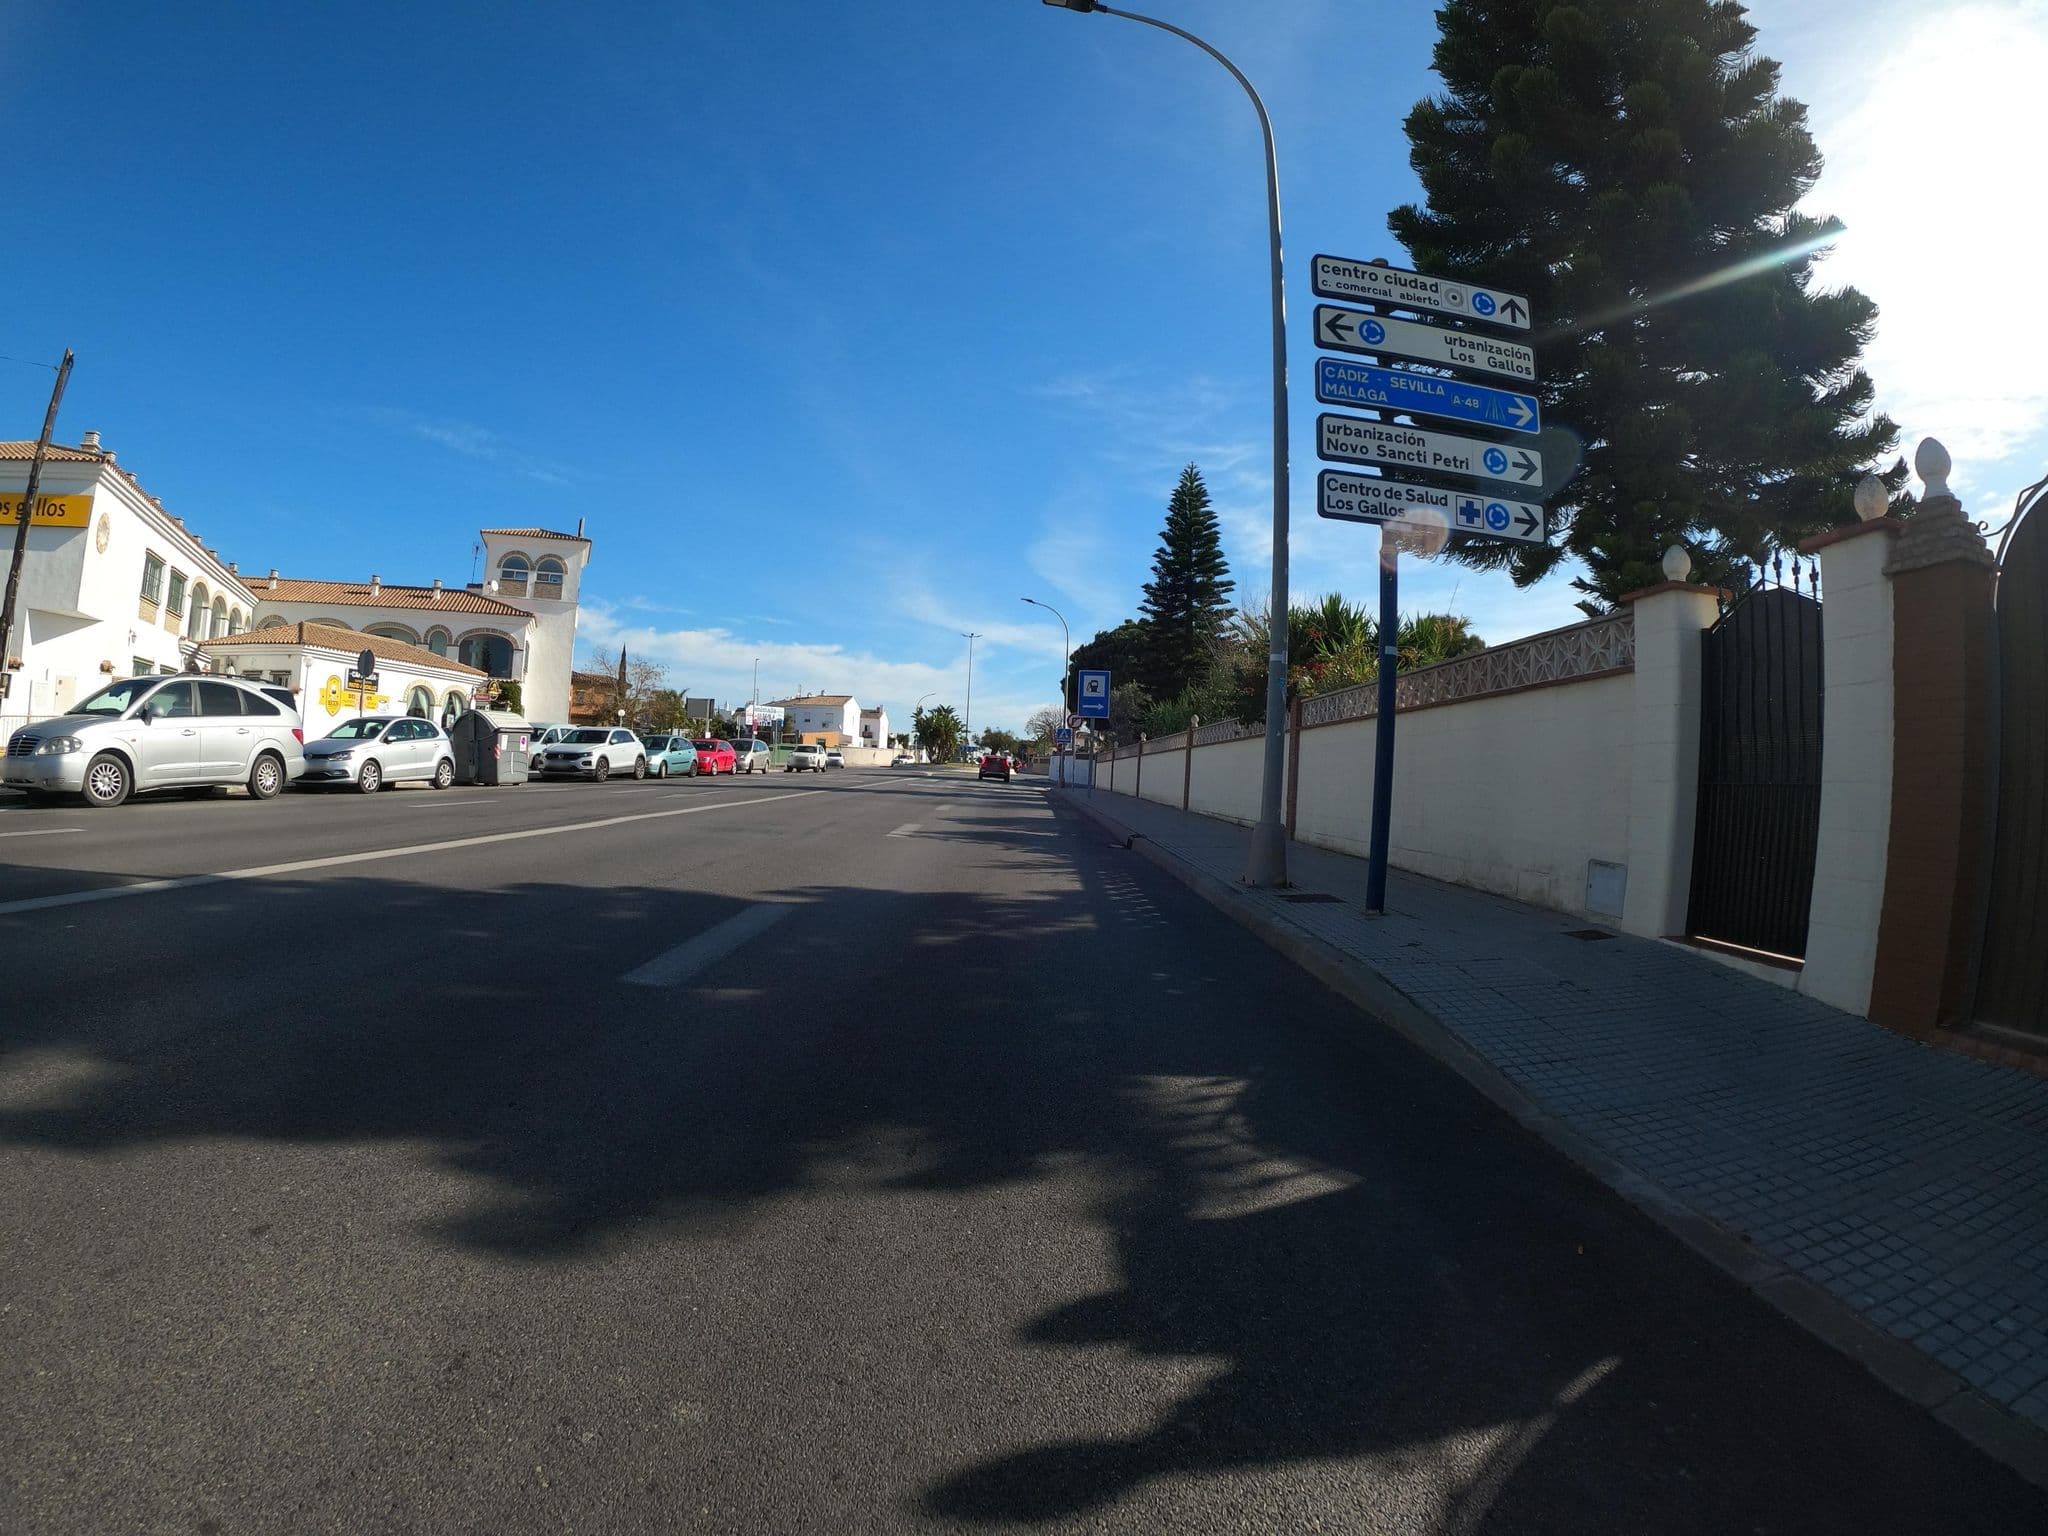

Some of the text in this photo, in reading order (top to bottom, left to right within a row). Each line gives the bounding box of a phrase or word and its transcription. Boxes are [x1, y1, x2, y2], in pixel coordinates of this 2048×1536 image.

[1321, 263, 1439, 294] centro ciudad
[1321, 278, 1440, 306] c. comercial abierto
[1444, 335, 1531, 362] urbanización
[1450, 348, 1532, 376] Los Gallos
[1324, 365, 1369, 383] CÁDIZ
[1390, 377, 1445, 397] SEVILLA
[1324, 381, 1388, 403] MÁLAGA
[1453, 395, 1480, 409] A-48
[1326, 422, 1425, 447] urbanización
[1326, 438, 1469, 470] Novo Sancti Petri
[1326, 478, 1448, 507] Centro de Salud
[14, 498, 66, 520] gllos
[1326, 495, 1405, 518] Los Gallos
